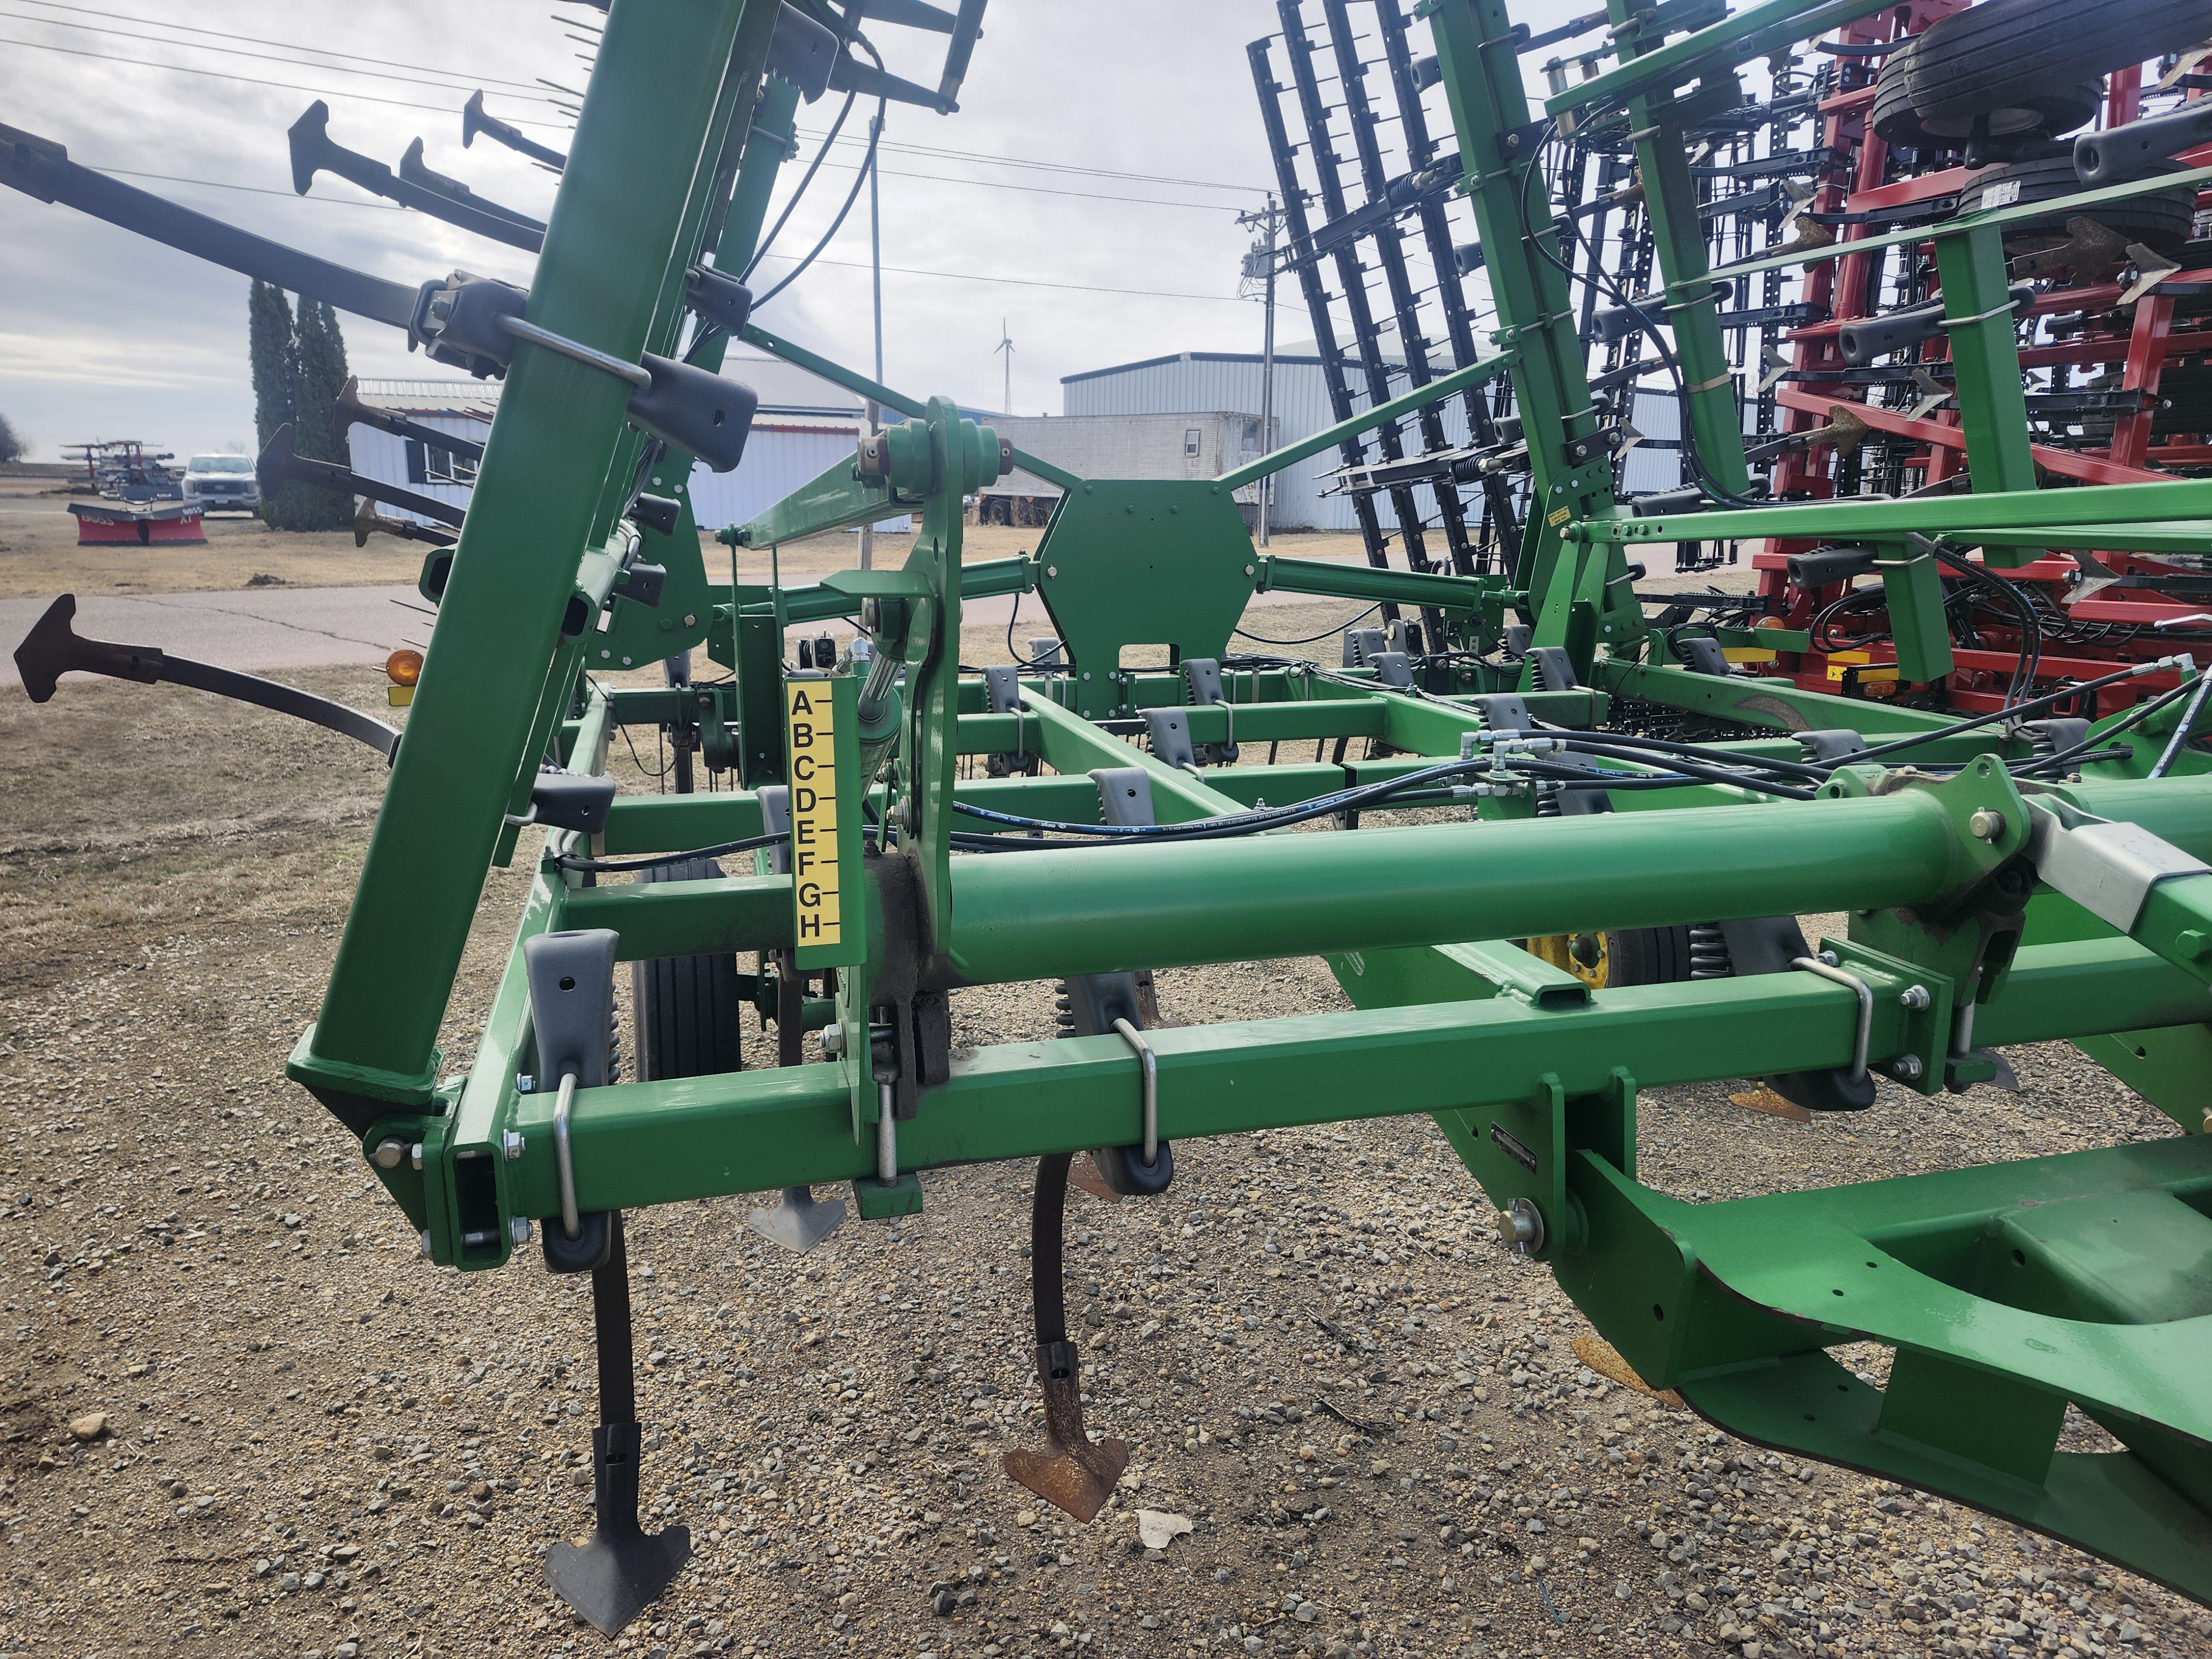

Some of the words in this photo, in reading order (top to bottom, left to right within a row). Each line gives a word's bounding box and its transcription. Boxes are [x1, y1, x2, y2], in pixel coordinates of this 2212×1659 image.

[182, 507, 202, 515] BOSS
[1551, 512, 1567, 521] LOCATION
[792, 691, 813, 715] A
[794, 723, 813, 748] B
[795, 755, 814, 780] C
[796, 789, 816, 812] D
[797, 820, 815, 844] E
[799, 852, 815, 875] F
[799, 883, 820, 907] G
[801, 914, 820, 938] H
